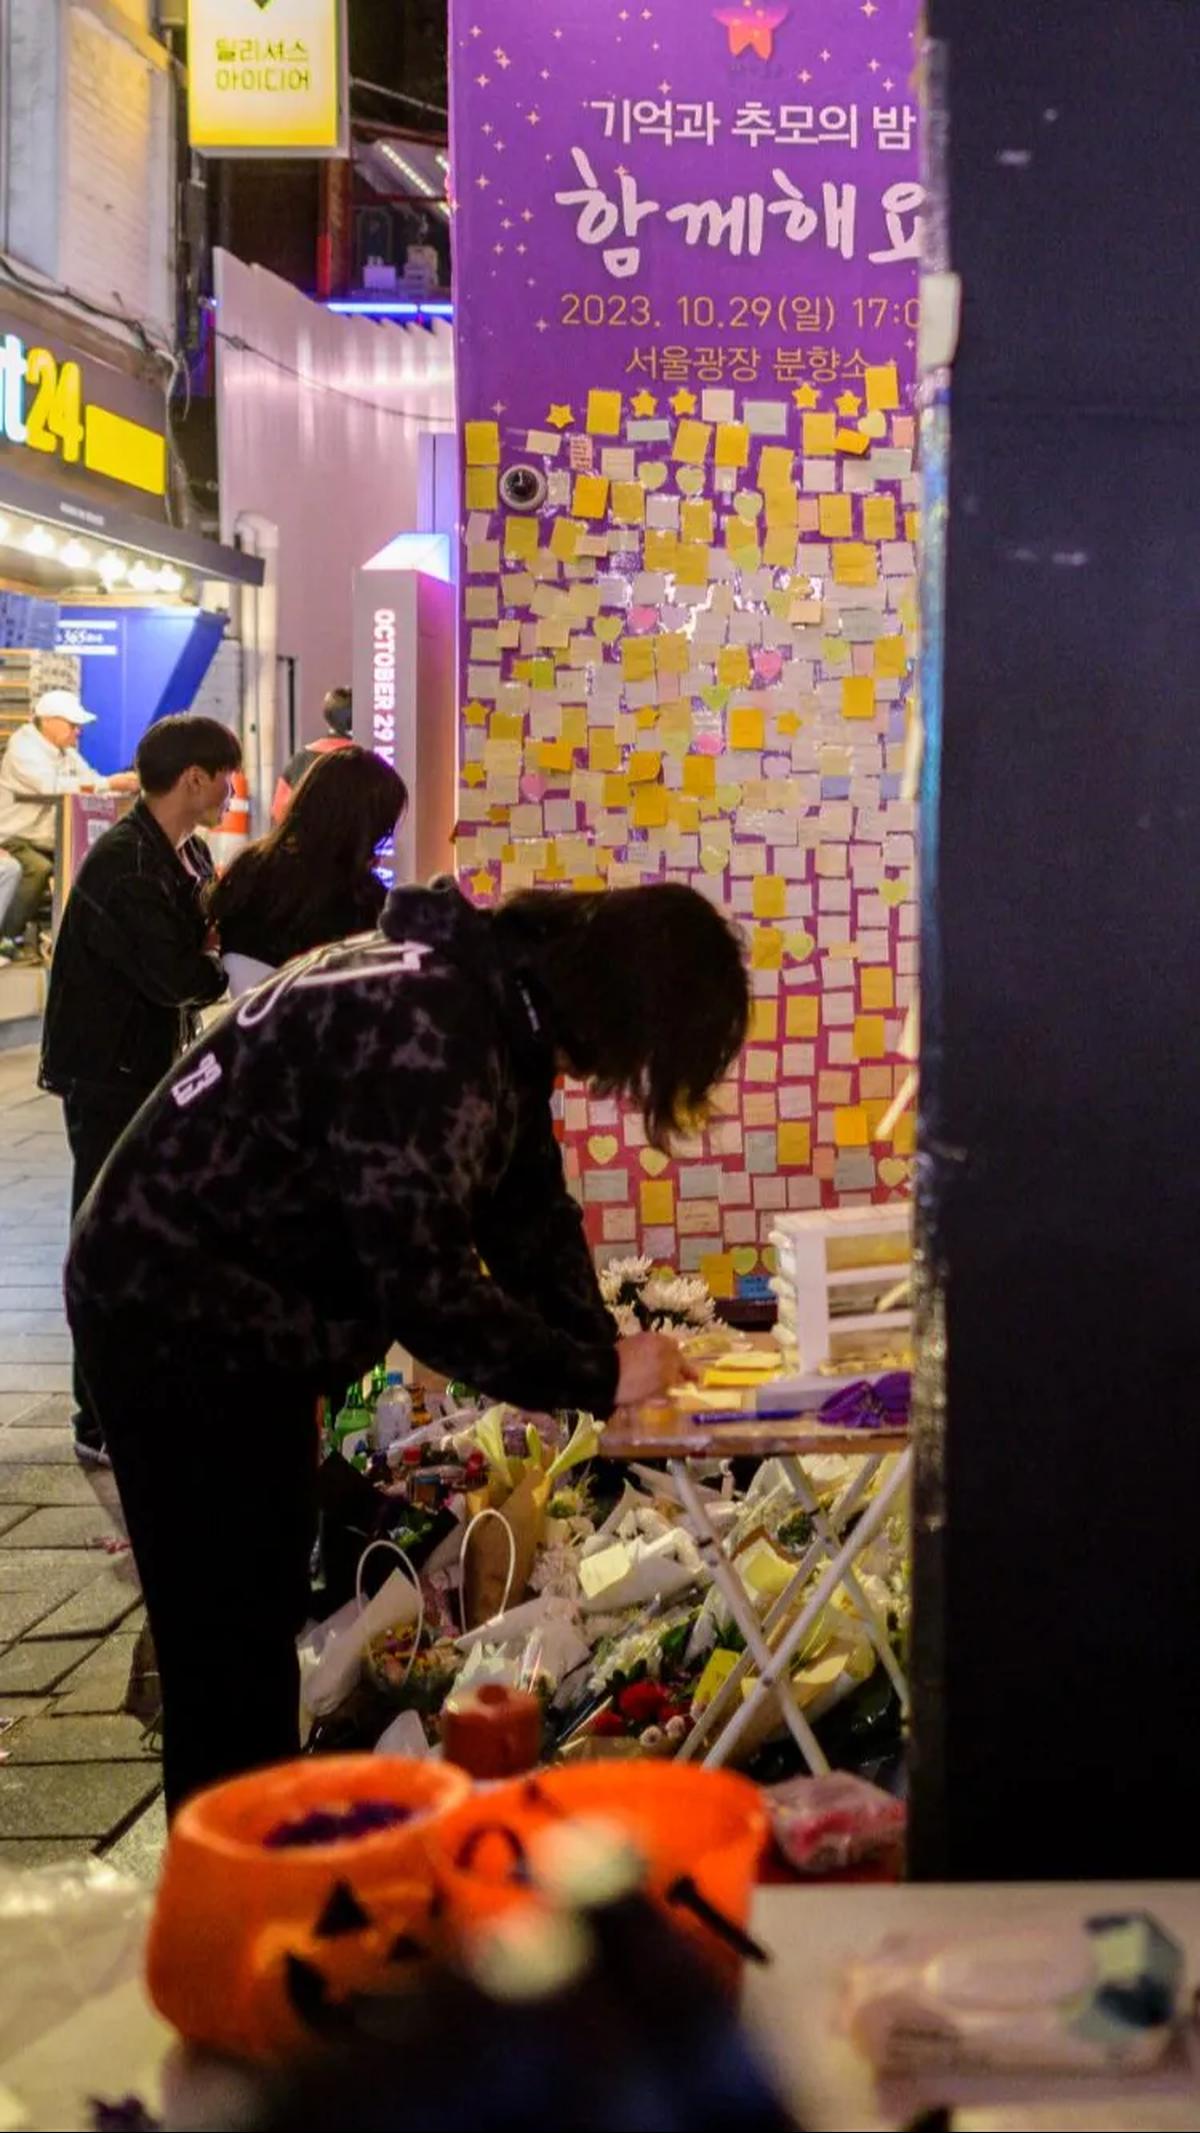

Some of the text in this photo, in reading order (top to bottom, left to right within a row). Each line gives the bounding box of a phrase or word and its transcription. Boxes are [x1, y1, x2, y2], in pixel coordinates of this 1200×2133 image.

[215, 68, 309, 91] 아이디어
[590, 100, 916, 151] 기억과 추모의 밤
[554, 146, 926, 278] 함께해요
[560, 294, 661, 327] 2023.
[677, 295, 834, 332] 10.29(일)
[625, 345, 869, 383] 서울광장 분향소
[373, 608, 395, 709] OCTOBER
[373, 716, 395, 745] 29
